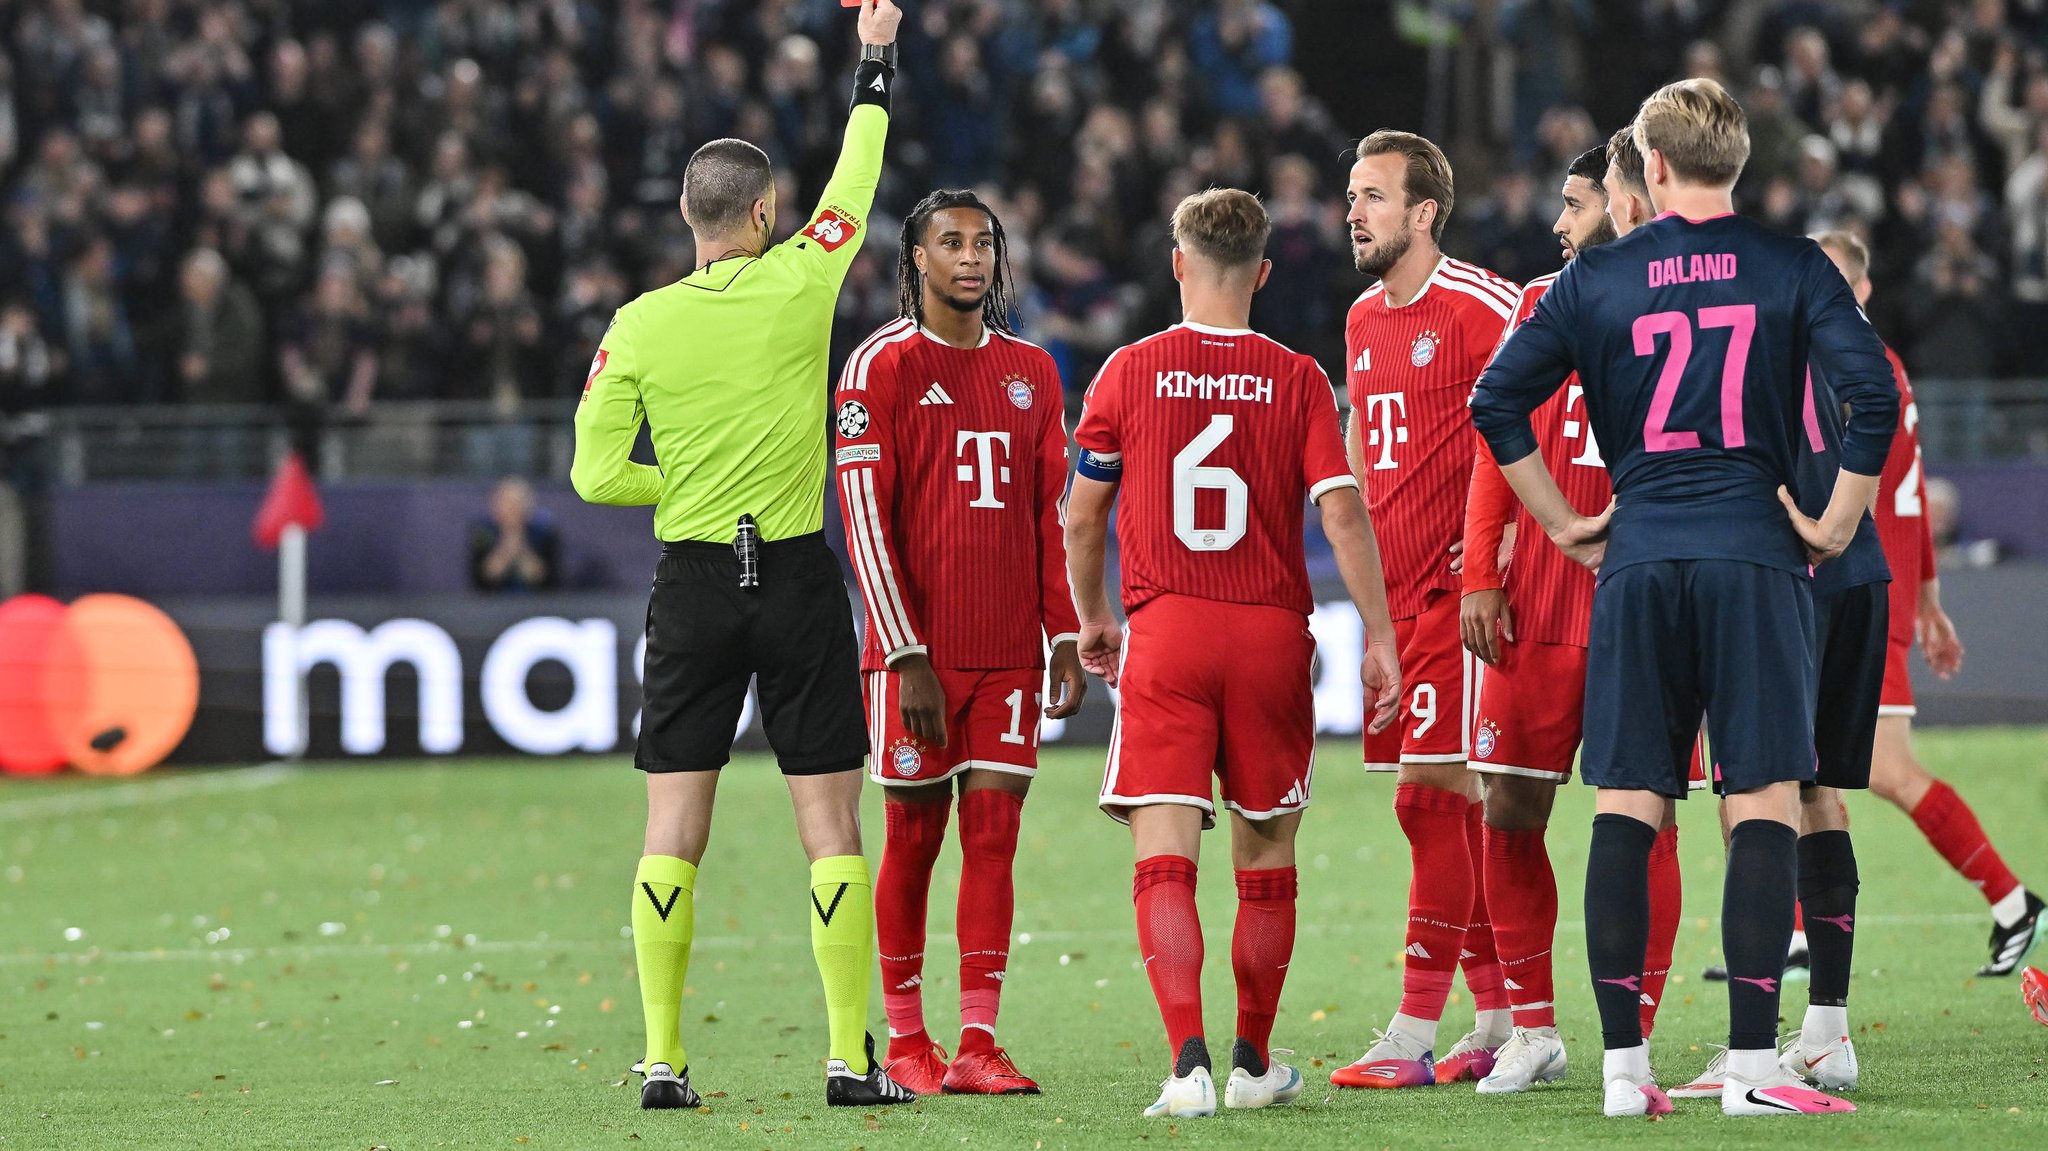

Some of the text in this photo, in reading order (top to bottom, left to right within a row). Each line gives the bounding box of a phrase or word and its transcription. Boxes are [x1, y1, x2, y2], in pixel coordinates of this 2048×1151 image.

[1648, 254, 1737, 288] DALAND
[1156, 371, 1273, 404] KIMMICH
[1632, 304, 1756, 452] 27
[836, 449, 879, 459] FOUNDATION
[1367, 392, 1408, 470] T
[957, 430, 1011, 509] T
[1173, 414, 1248, 551] 6
[1410, 683, 1437, 738] 9
